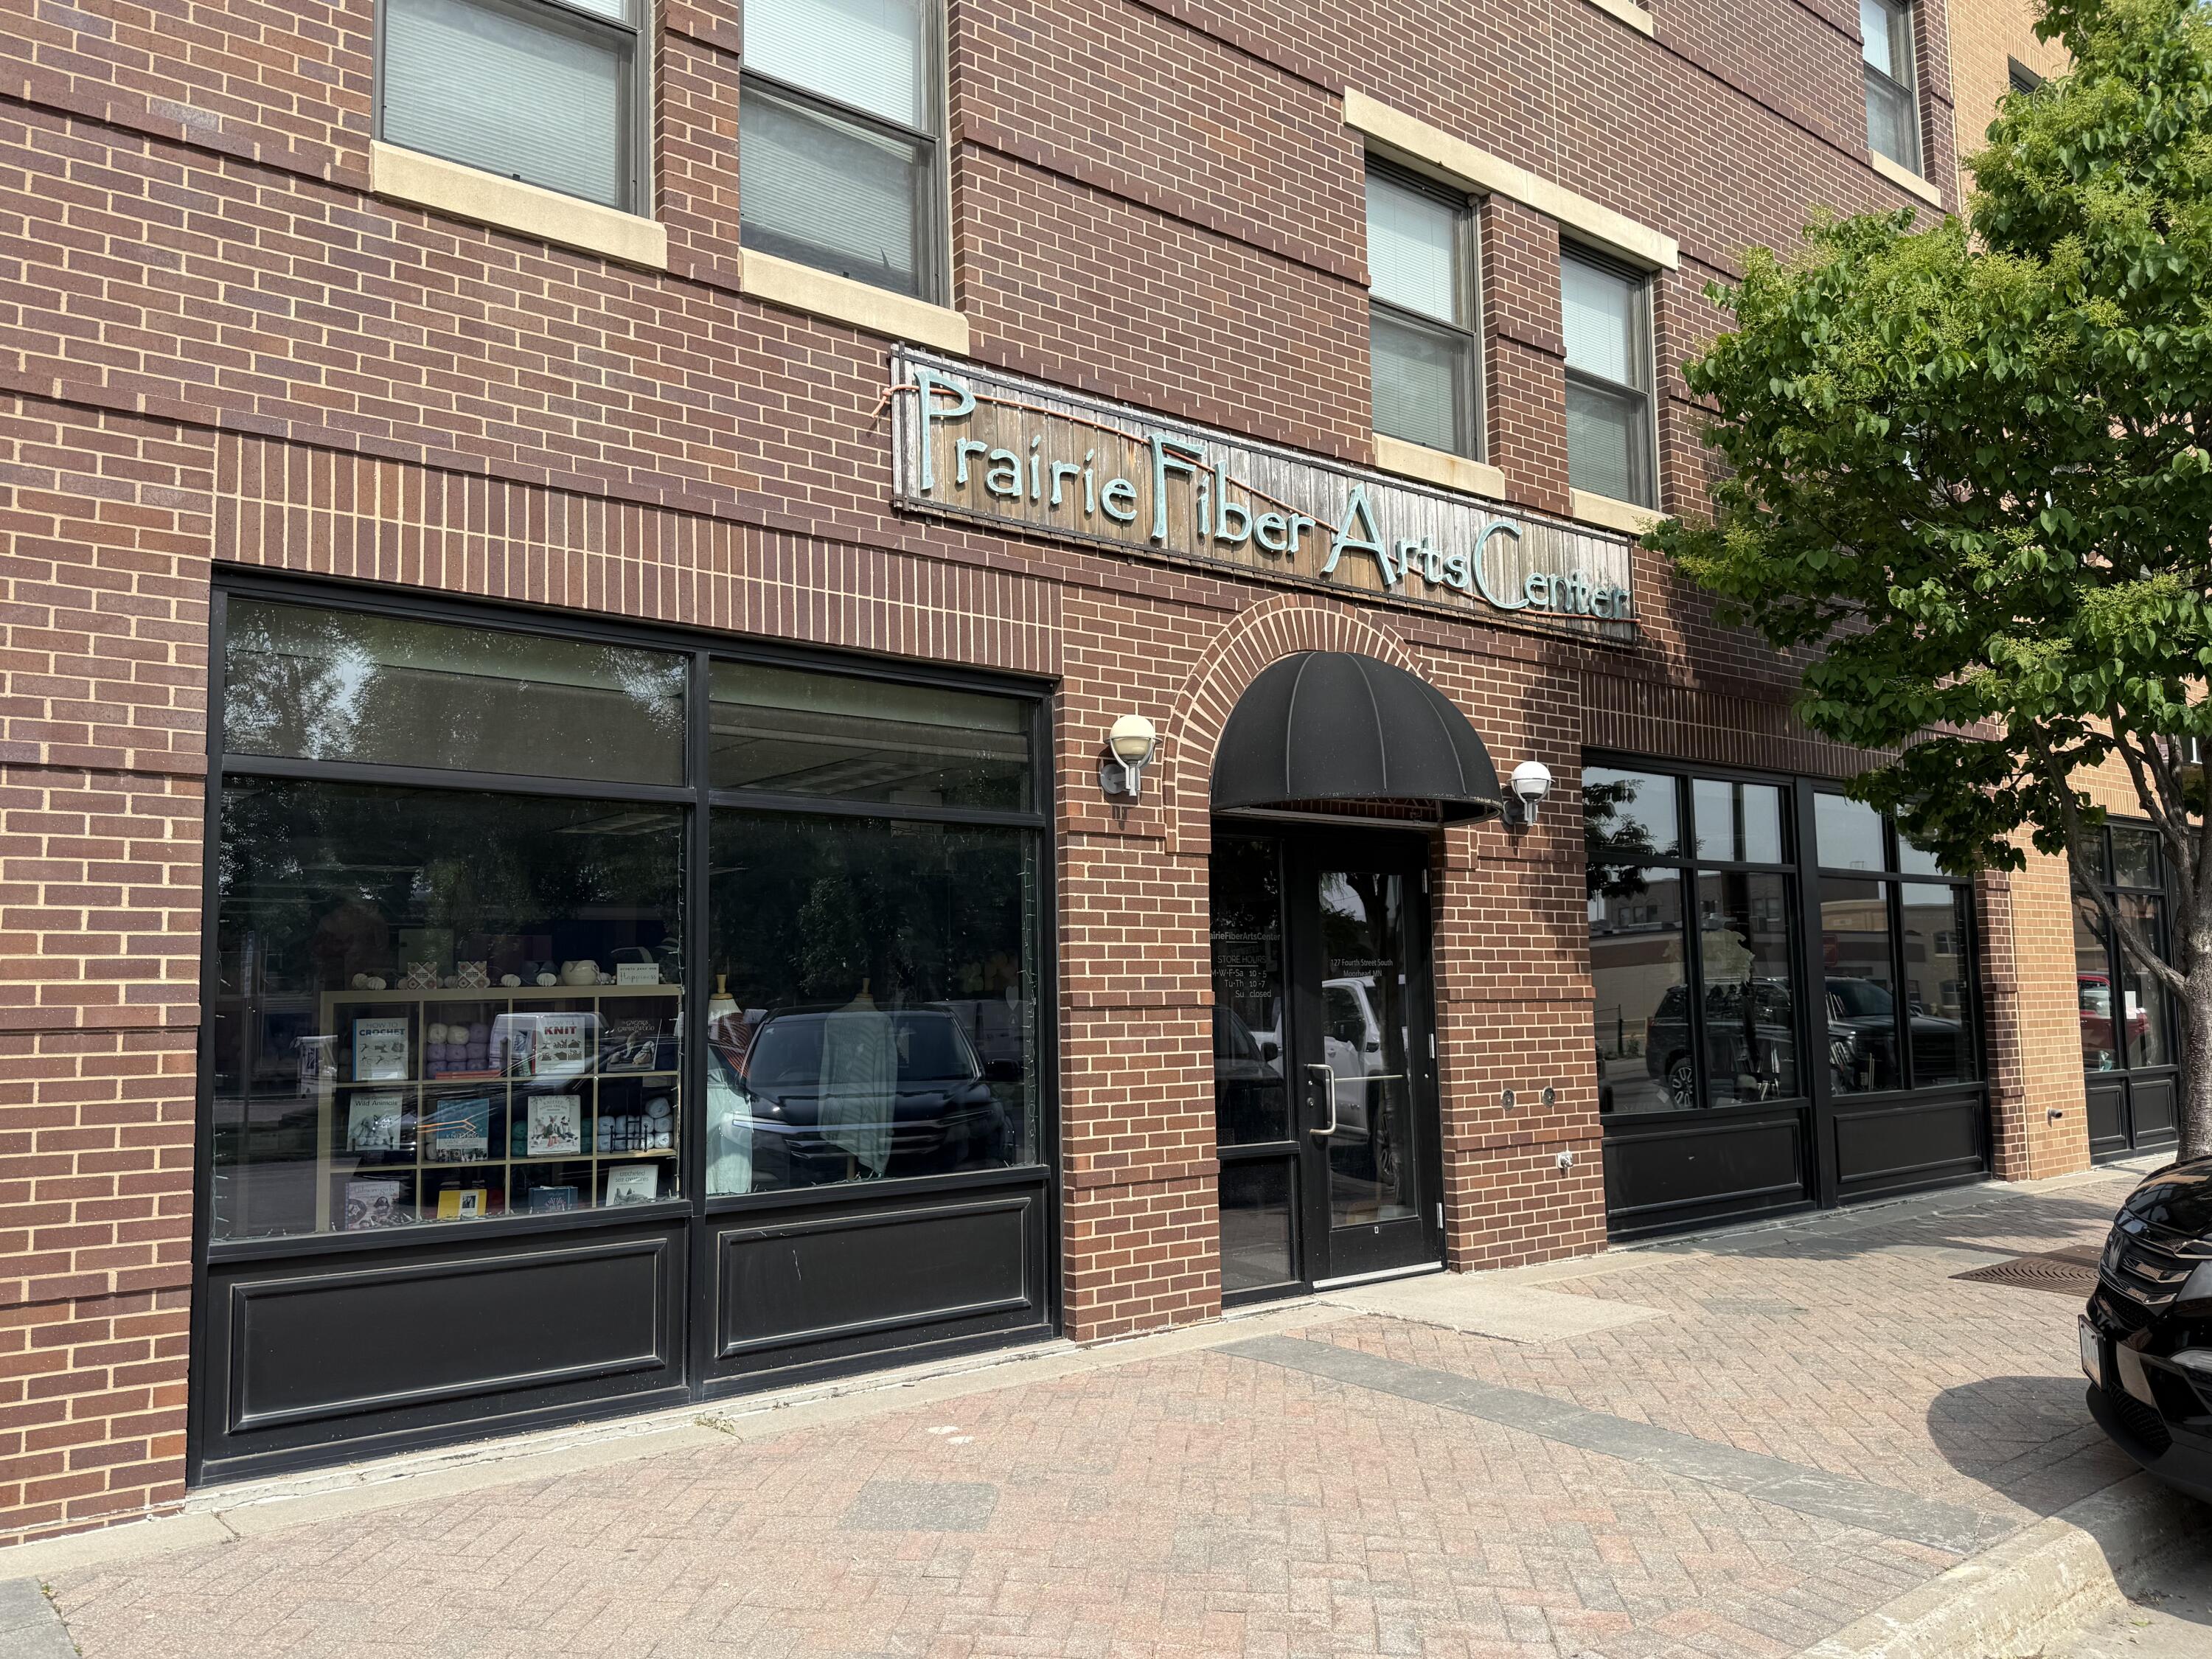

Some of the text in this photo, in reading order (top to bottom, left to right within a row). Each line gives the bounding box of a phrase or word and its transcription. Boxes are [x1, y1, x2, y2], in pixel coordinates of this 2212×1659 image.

[914, 369, 1631, 619] Prairie Fiber Arts Center
[1210, 931, 1281, 941] airieFiberArtsCenter
[1217, 955, 1267, 964] STORE HOURS
[1331, 959, 1340, 967] 127
[1235, 989, 1272, 998] Su closed
[358, 1028, 406, 1037] CROCHET
[544, 1026, 577, 1035] KNIT
